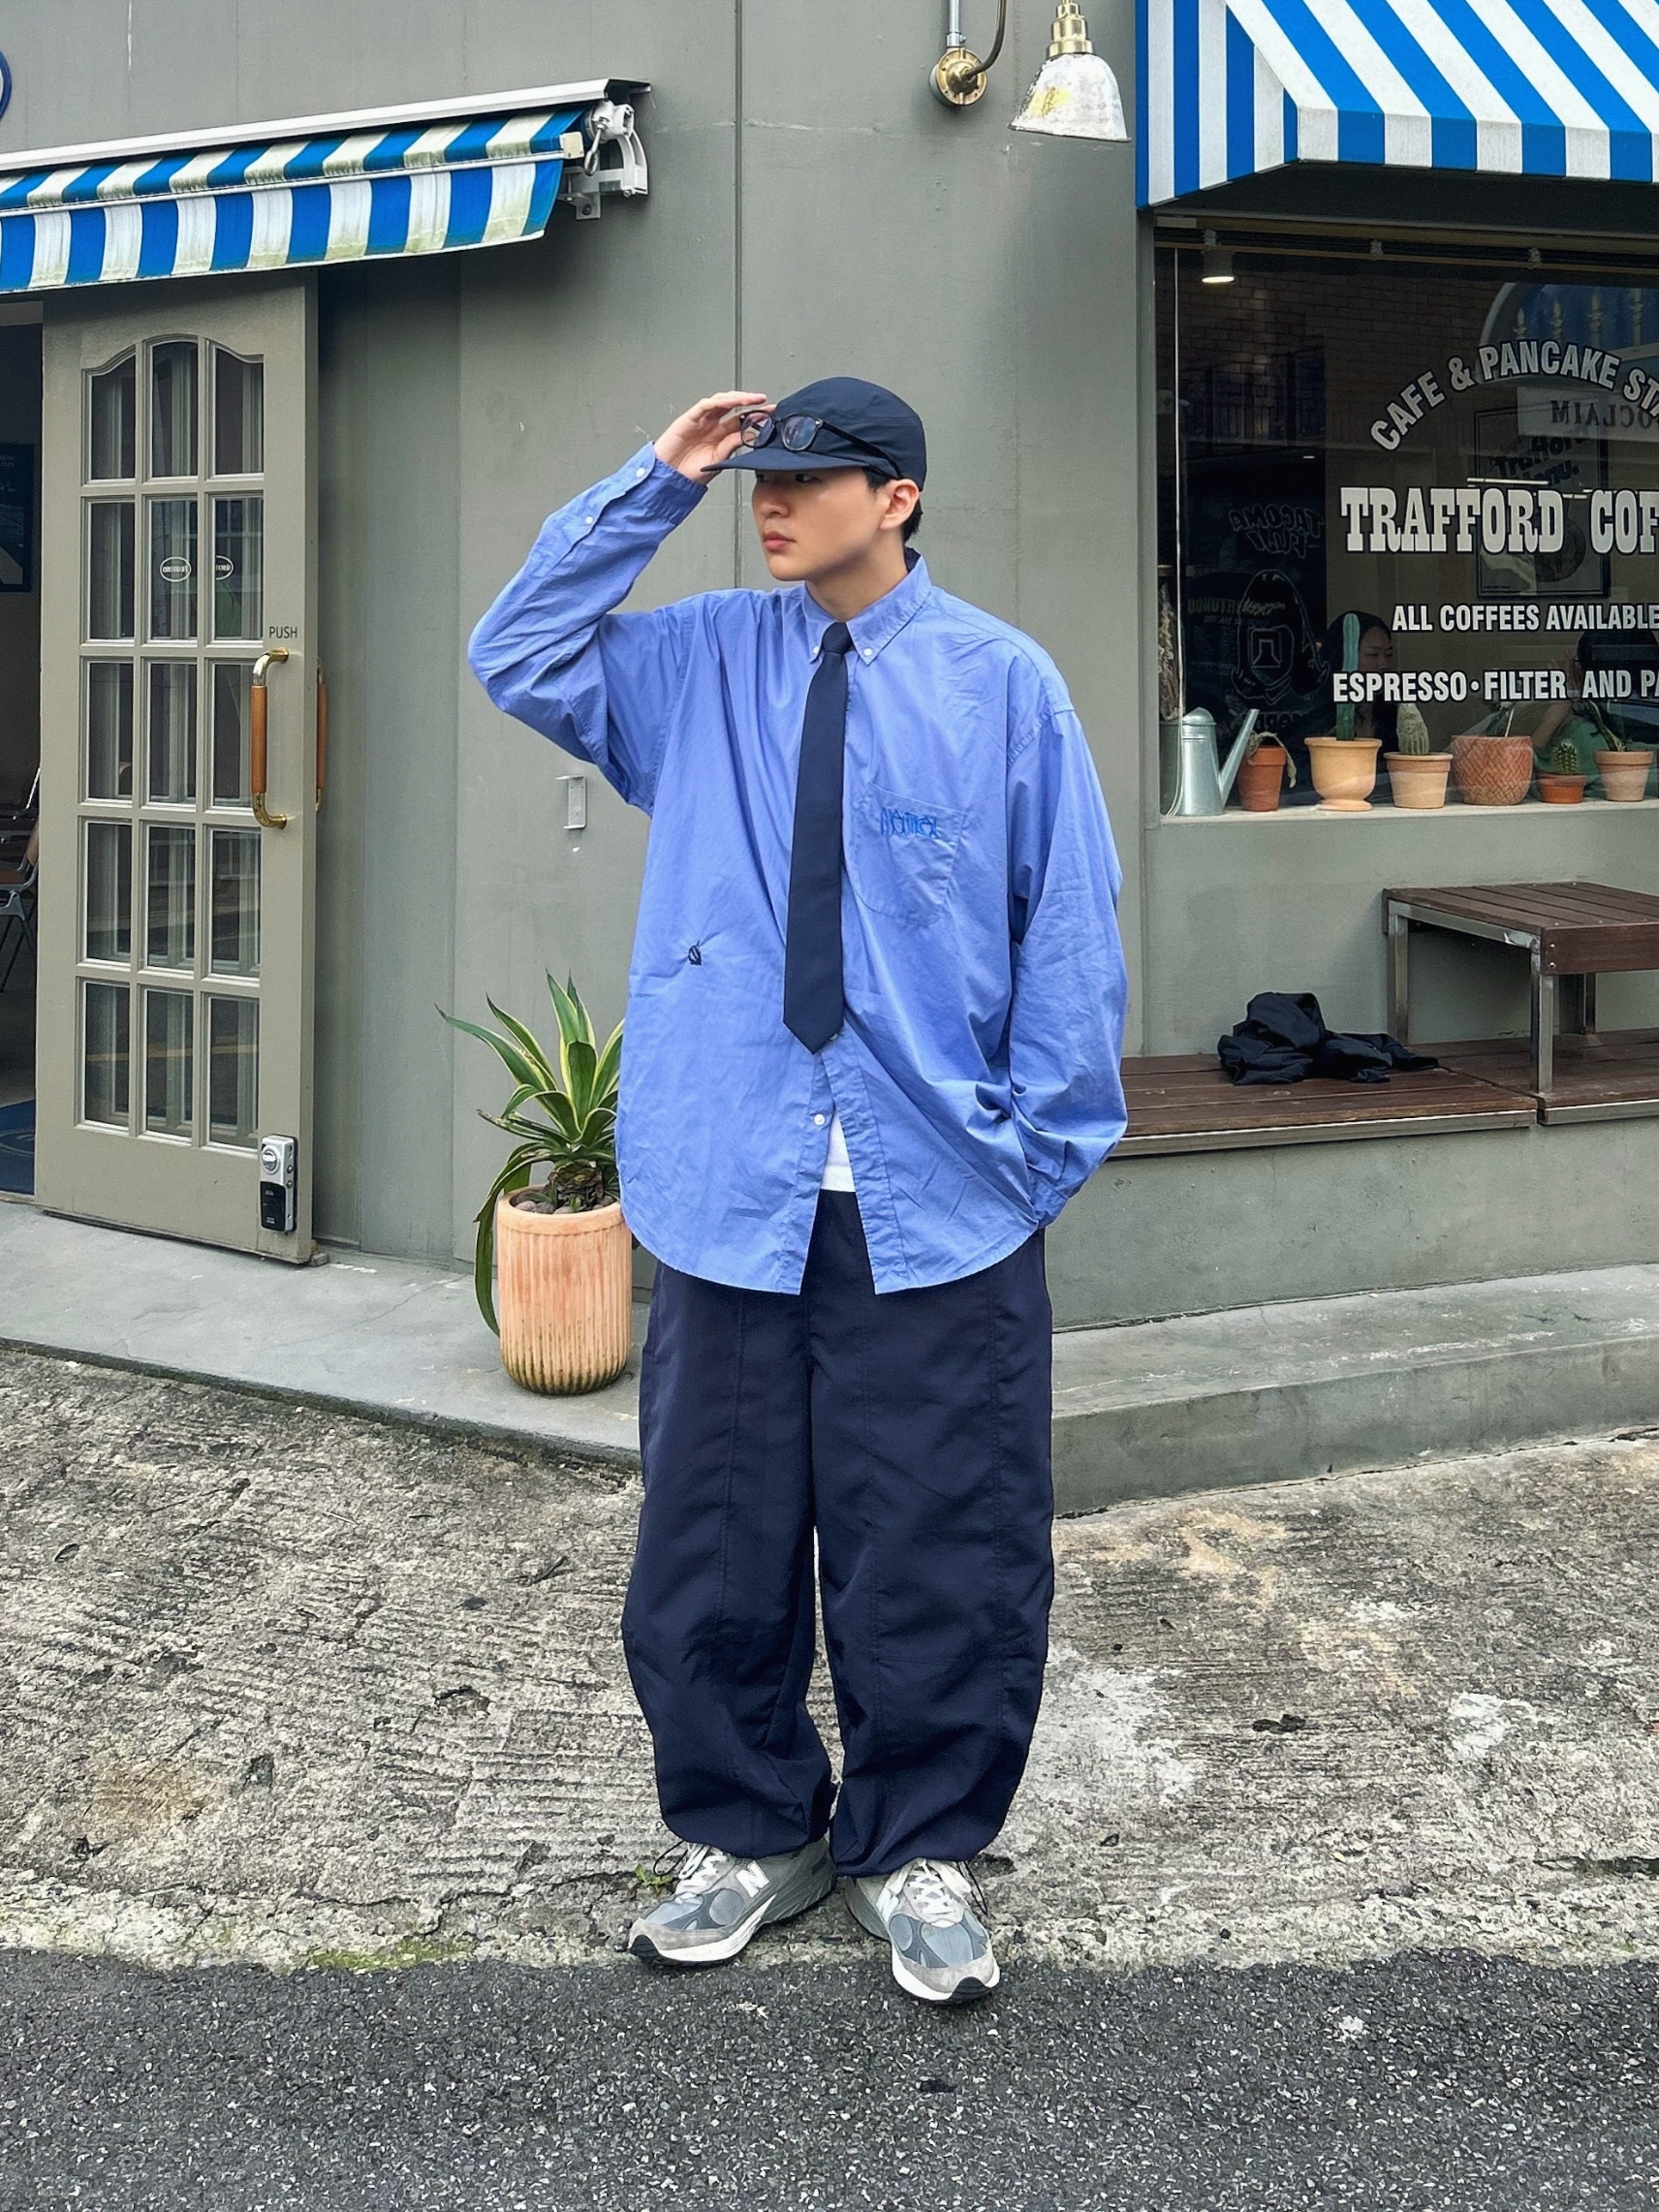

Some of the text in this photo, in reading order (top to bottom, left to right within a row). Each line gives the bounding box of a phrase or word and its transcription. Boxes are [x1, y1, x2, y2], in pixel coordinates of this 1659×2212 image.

[1370, 340, 1659, 452] CAFE & PANCAKE ST
[1340, 487, 1564, 553] TRAFFORD
[268, 626, 297, 639] PUSH
[1392, 605, 1659, 631] ALL COFFEES AVAILABLE
[1581, 670, 1632, 698] AND
[736, 1860, 769, 1898] N
